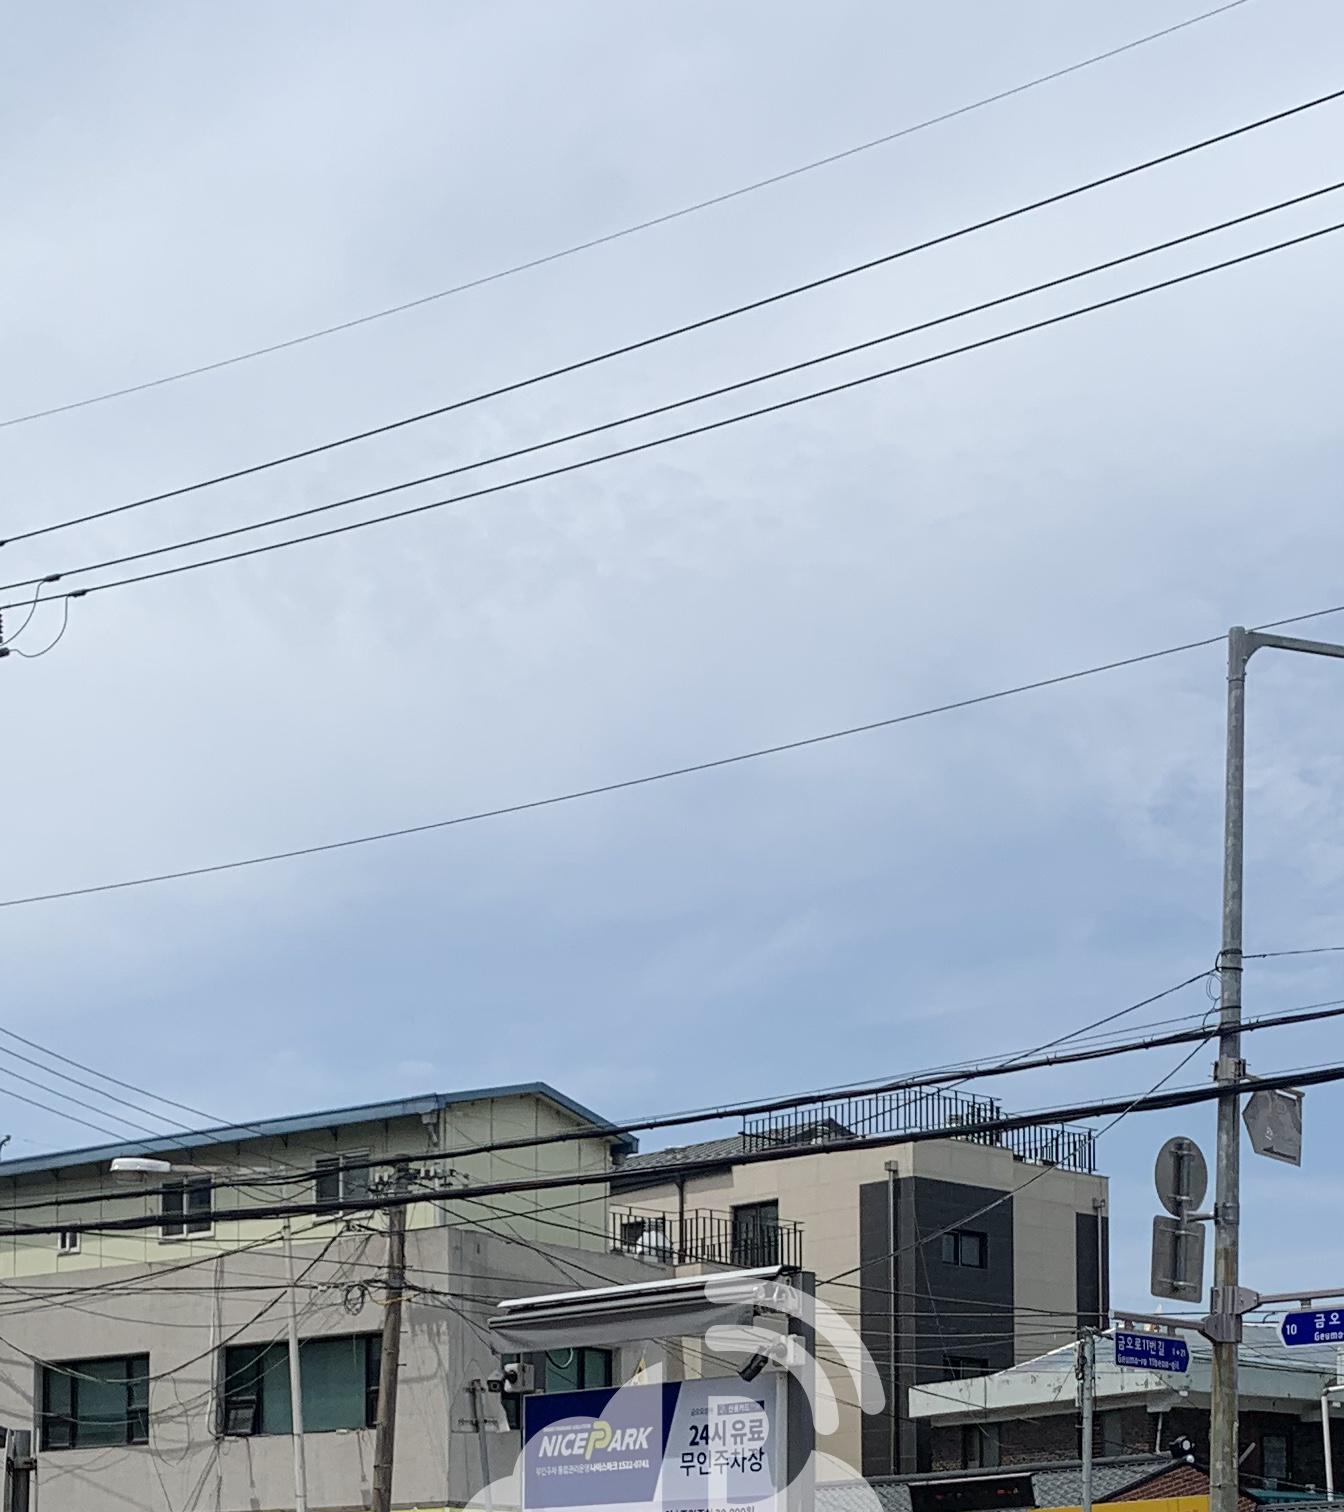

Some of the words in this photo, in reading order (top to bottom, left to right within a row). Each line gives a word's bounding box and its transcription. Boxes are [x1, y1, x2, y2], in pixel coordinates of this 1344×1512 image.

[1285, 1323, 1298, 1336] 10
[538, 1420, 653, 1461] NICEPARK
[689, 1419, 726, 1447] 24시
[730, 1418, 765, 1446] 유료
[679, 1446, 765, 1477] 무인주차장
